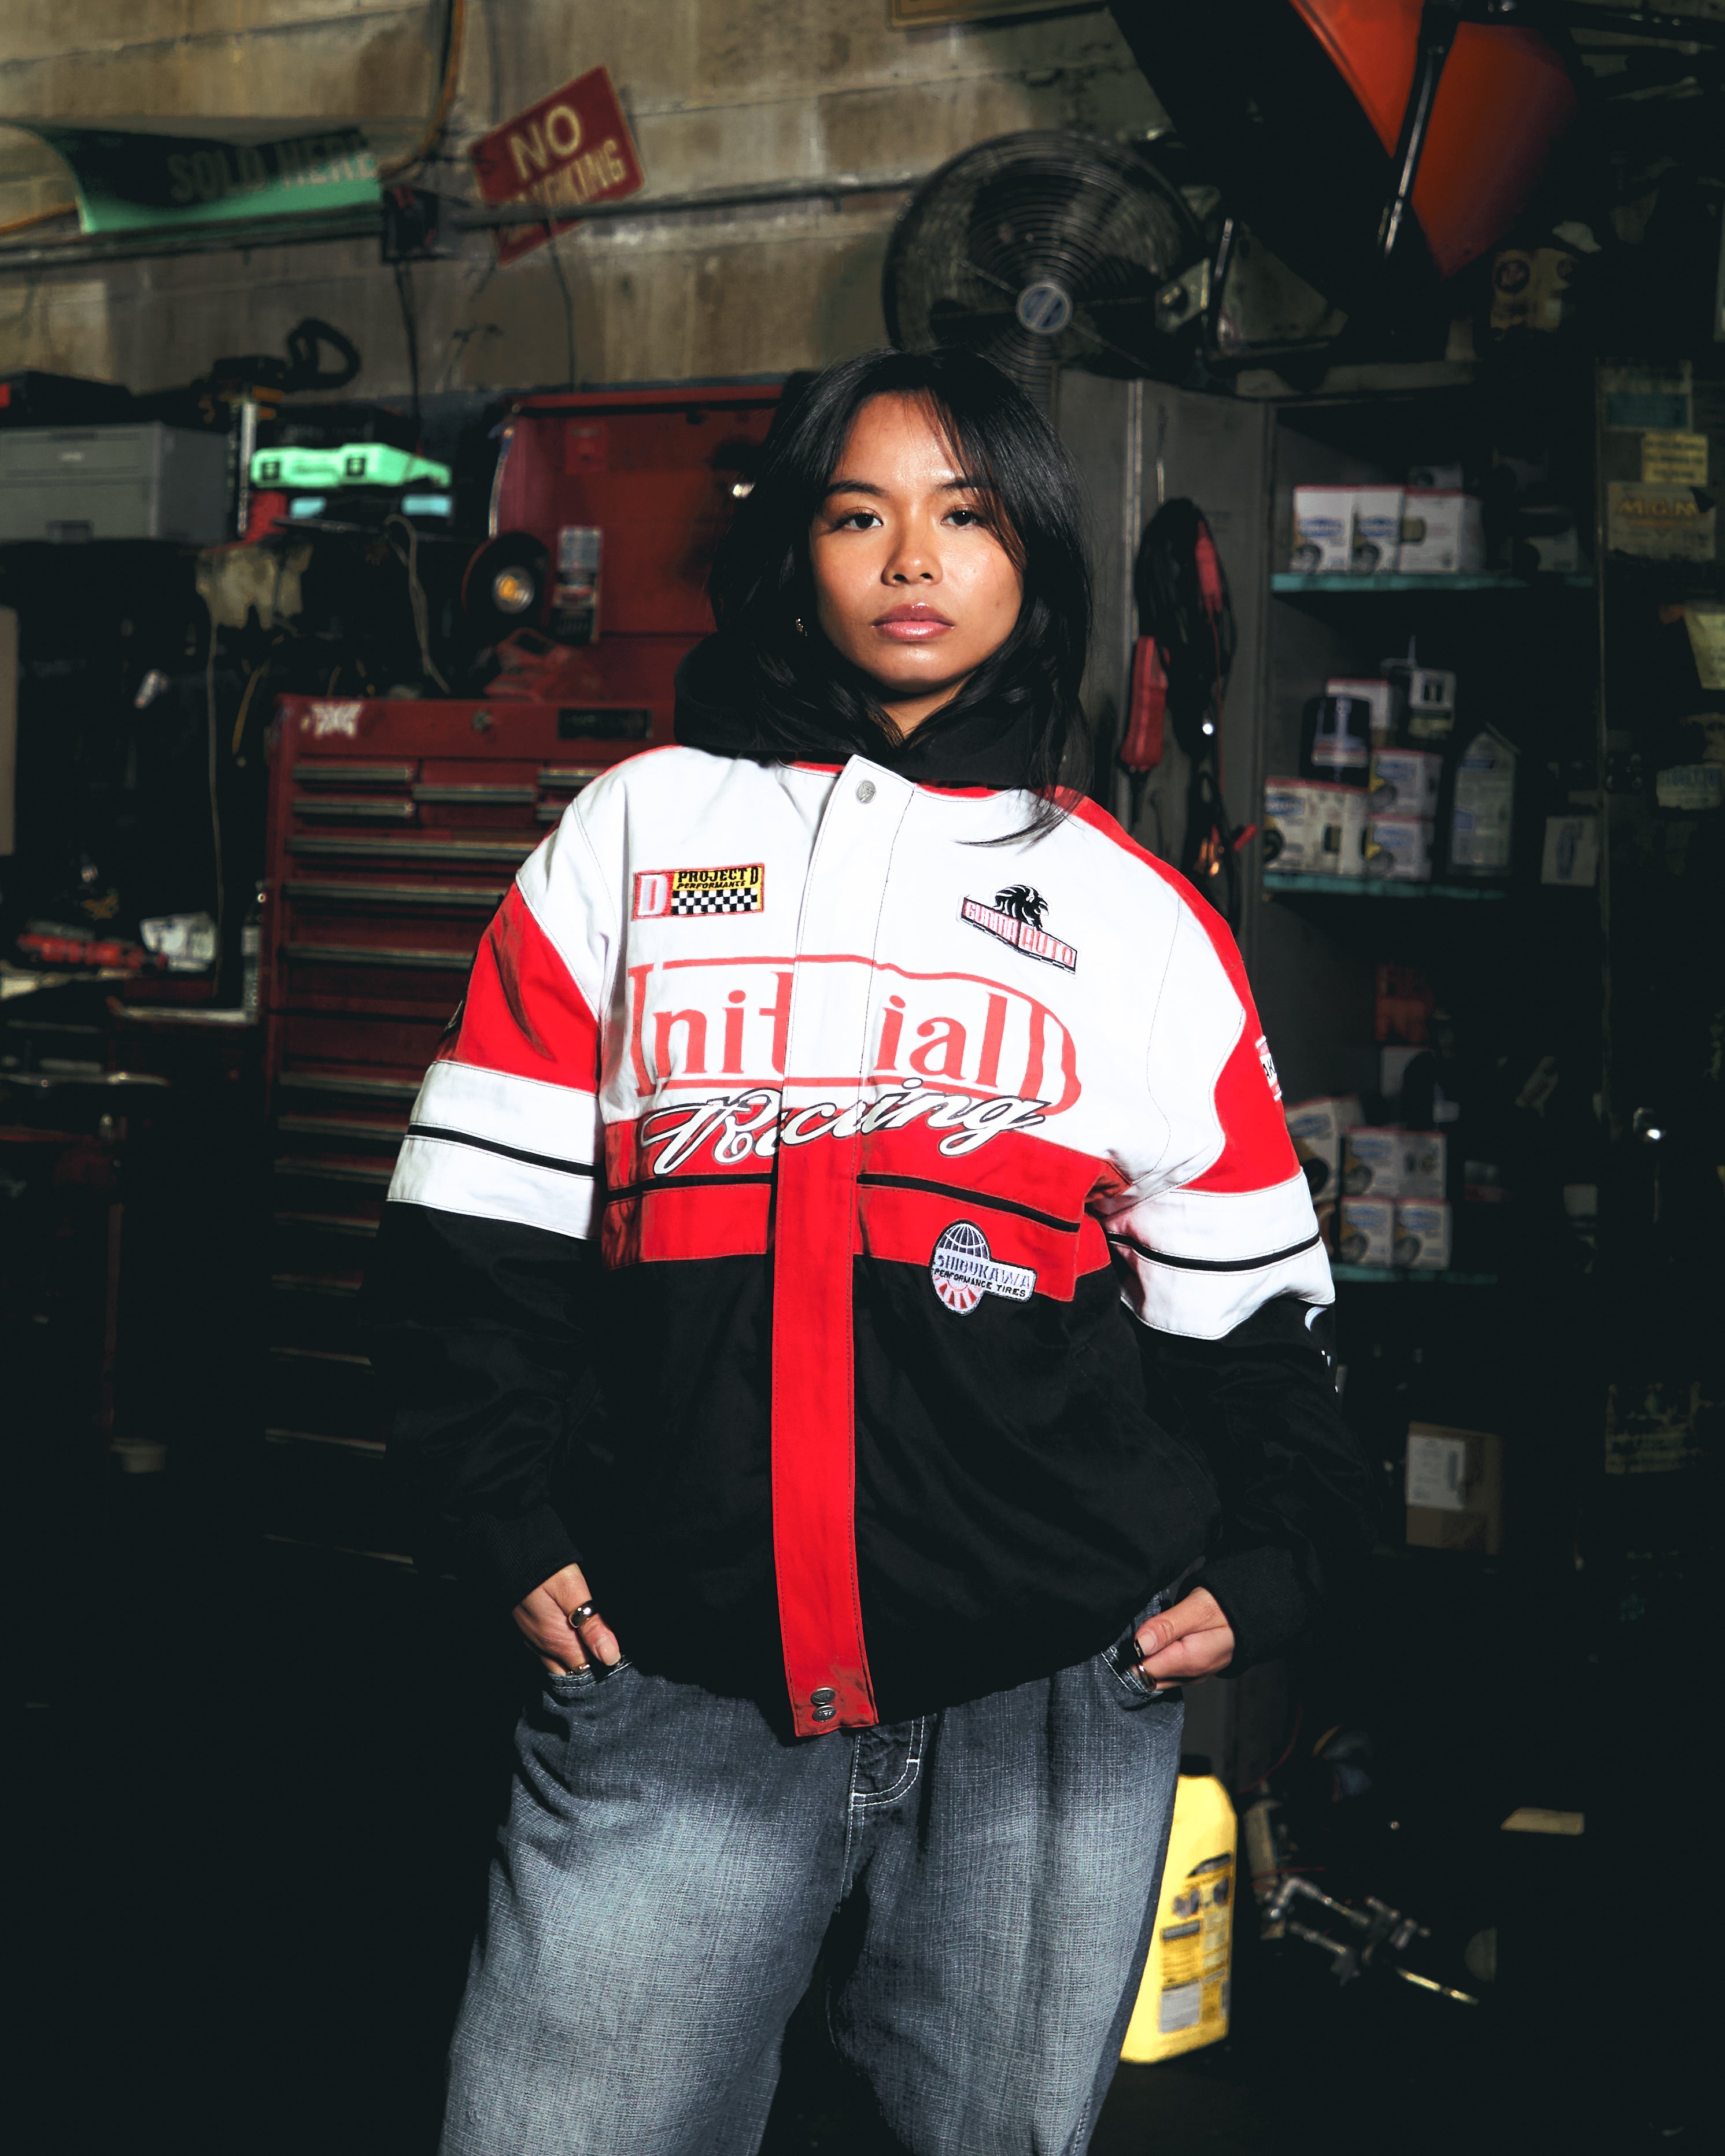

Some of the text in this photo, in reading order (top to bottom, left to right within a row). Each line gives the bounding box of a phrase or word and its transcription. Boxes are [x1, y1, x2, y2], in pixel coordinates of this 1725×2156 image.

[509, 104, 580, 180] NO
[167, 149, 268, 202] SOLD
[637, 874, 667, 916] D
[678, 866, 759, 886] PROJECT D
[1021, 925, 1073, 966] AUTO
[934, 1268, 1026, 1297] PERFORMANCE TIRES
[936, 1255, 1030, 1289] SHIBUKAWA
